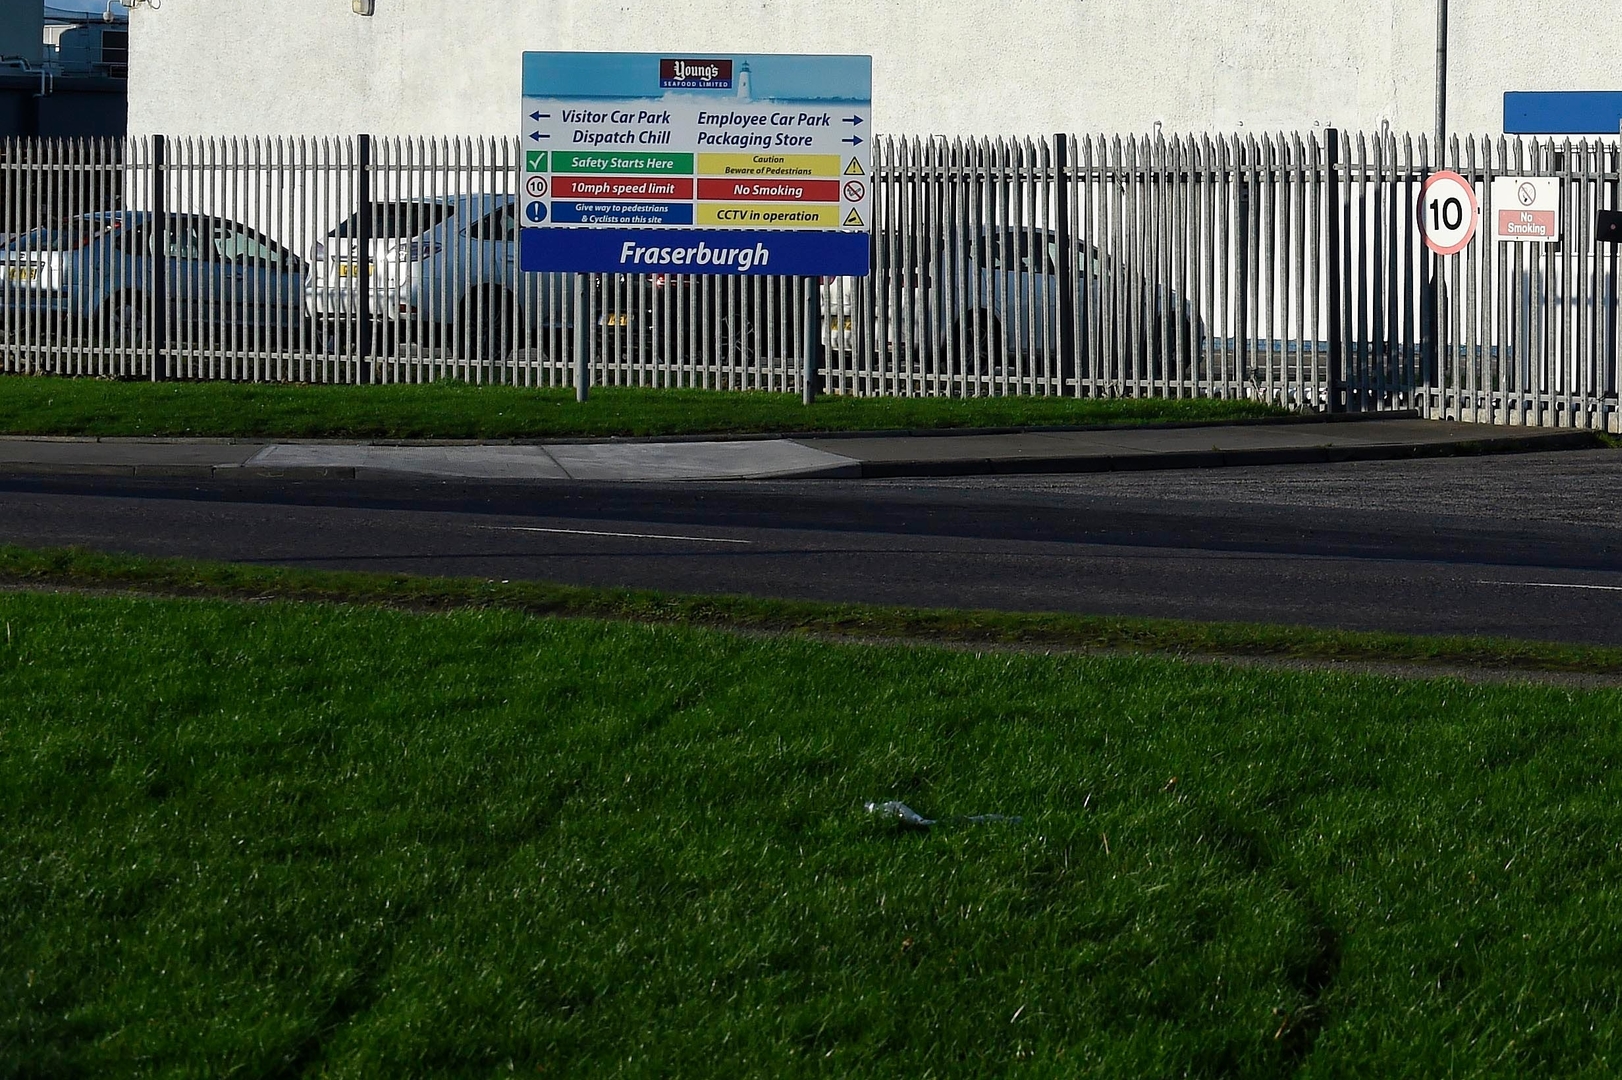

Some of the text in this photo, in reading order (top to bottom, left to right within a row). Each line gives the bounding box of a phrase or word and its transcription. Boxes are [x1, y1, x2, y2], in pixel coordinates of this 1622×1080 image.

[673, 61, 719, 81] Young's
[562, 110, 671, 124] Visitor Car Park
[698, 111, 831, 128] Employee Car Park
[573, 130, 671, 146] Dispatch Chill
[698, 132, 813, 148] Packaging Store
[572, 157, 674, 170] Safety Starts Here
[530, 181, 543, 193] 10
[571, 182, 674, 195] 10mph speed limit
[734, 185, 803, 198] No Smoking
[621, 204, 668, 213] pedestrians
[1430, 197, 1462, 230] 10
[589, 215, 618, 223] Cyclists
[717, 210, 819, 222] CCTV in operation
[1521, 212, 1532, 222] No
[1508, 223, 1545, 235] Smoking
[620, 241, 770, 269] Fraserburgh
